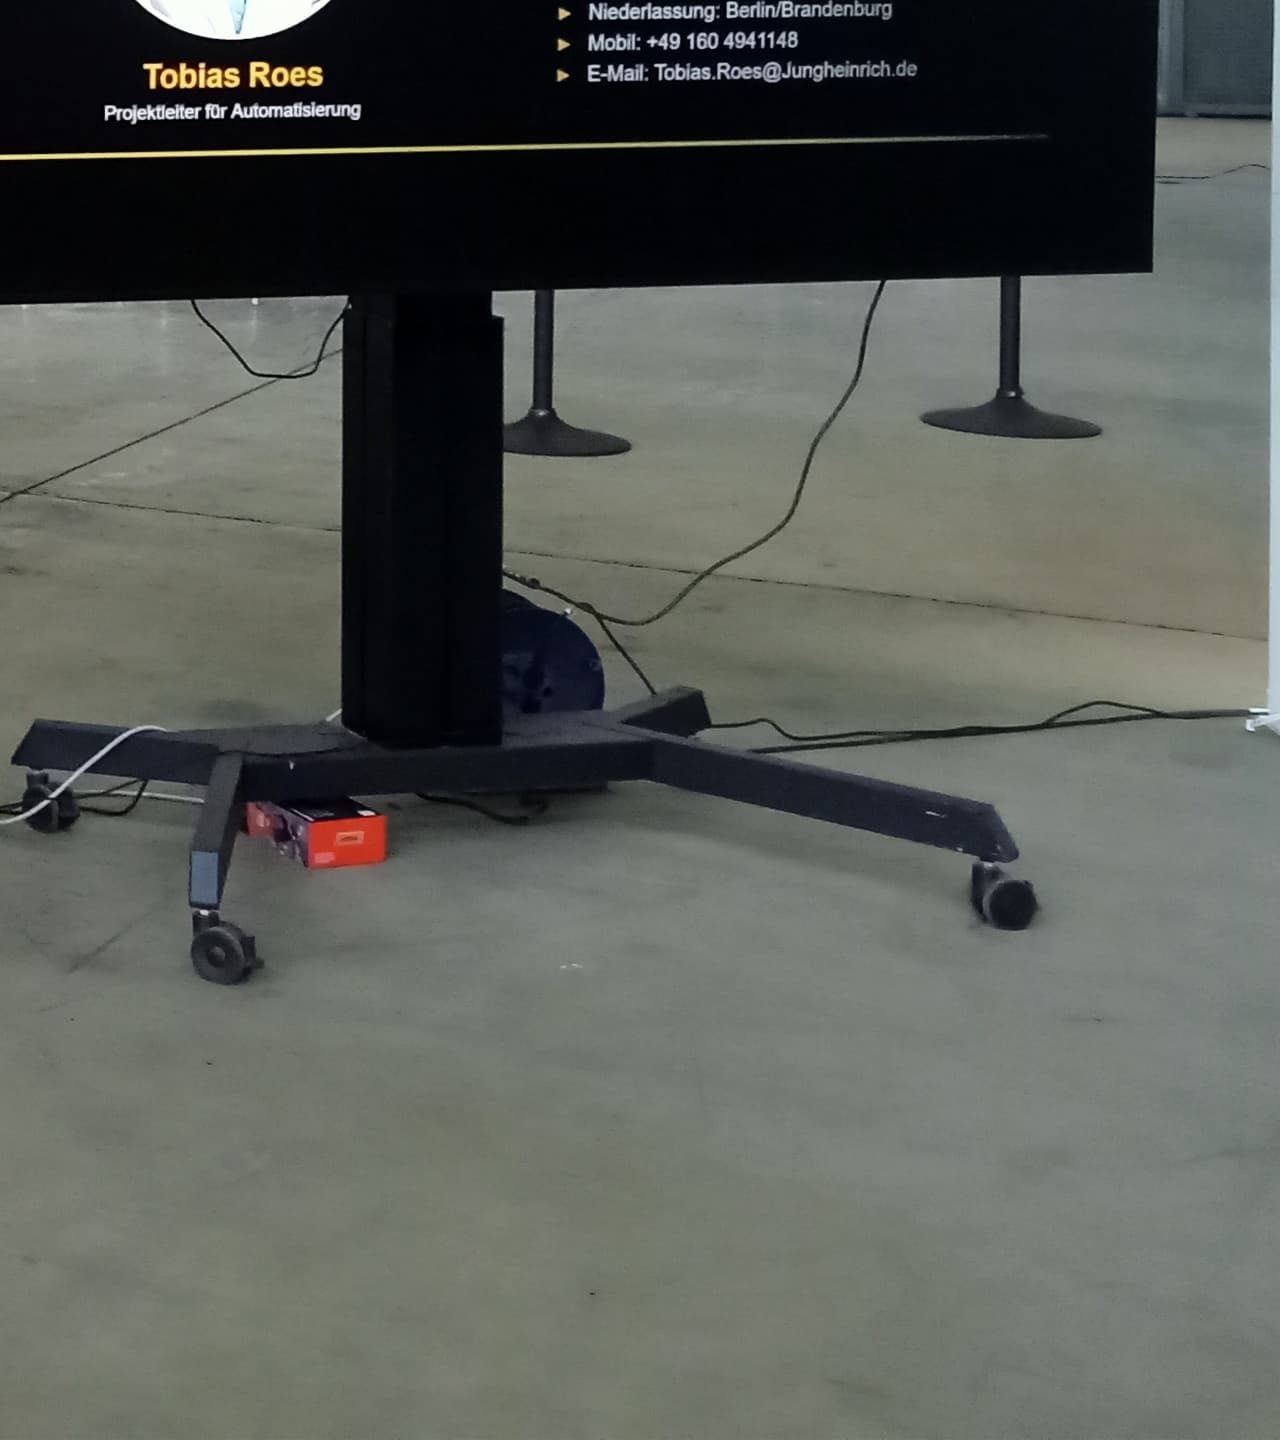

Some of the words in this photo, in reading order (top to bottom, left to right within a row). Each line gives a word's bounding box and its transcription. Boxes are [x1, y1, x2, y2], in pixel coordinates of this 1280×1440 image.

[588, 2, 721, 23] Niederlassung:
[725, 0, 893, 21] Berlin/Brandenburg
[587, 33, 642, 52] Mobil:
[646, 33, 681, 51] +49
[686, 32, 720, 51] 160
[722, 31, 799, 50] 4941148
[142, 62, 241, 90] Tobias
[248, 61, 324, 89] Roes
[587, 63, 649, 83] E-Mail:
[653, 60, 919, 84] Tobias.Roes@Jungheinrich.de
[104, 104, 202, 125] Projektleiter
[204, 103, 229, 119] für
[230, 101, 362, 121] Automatisierung
